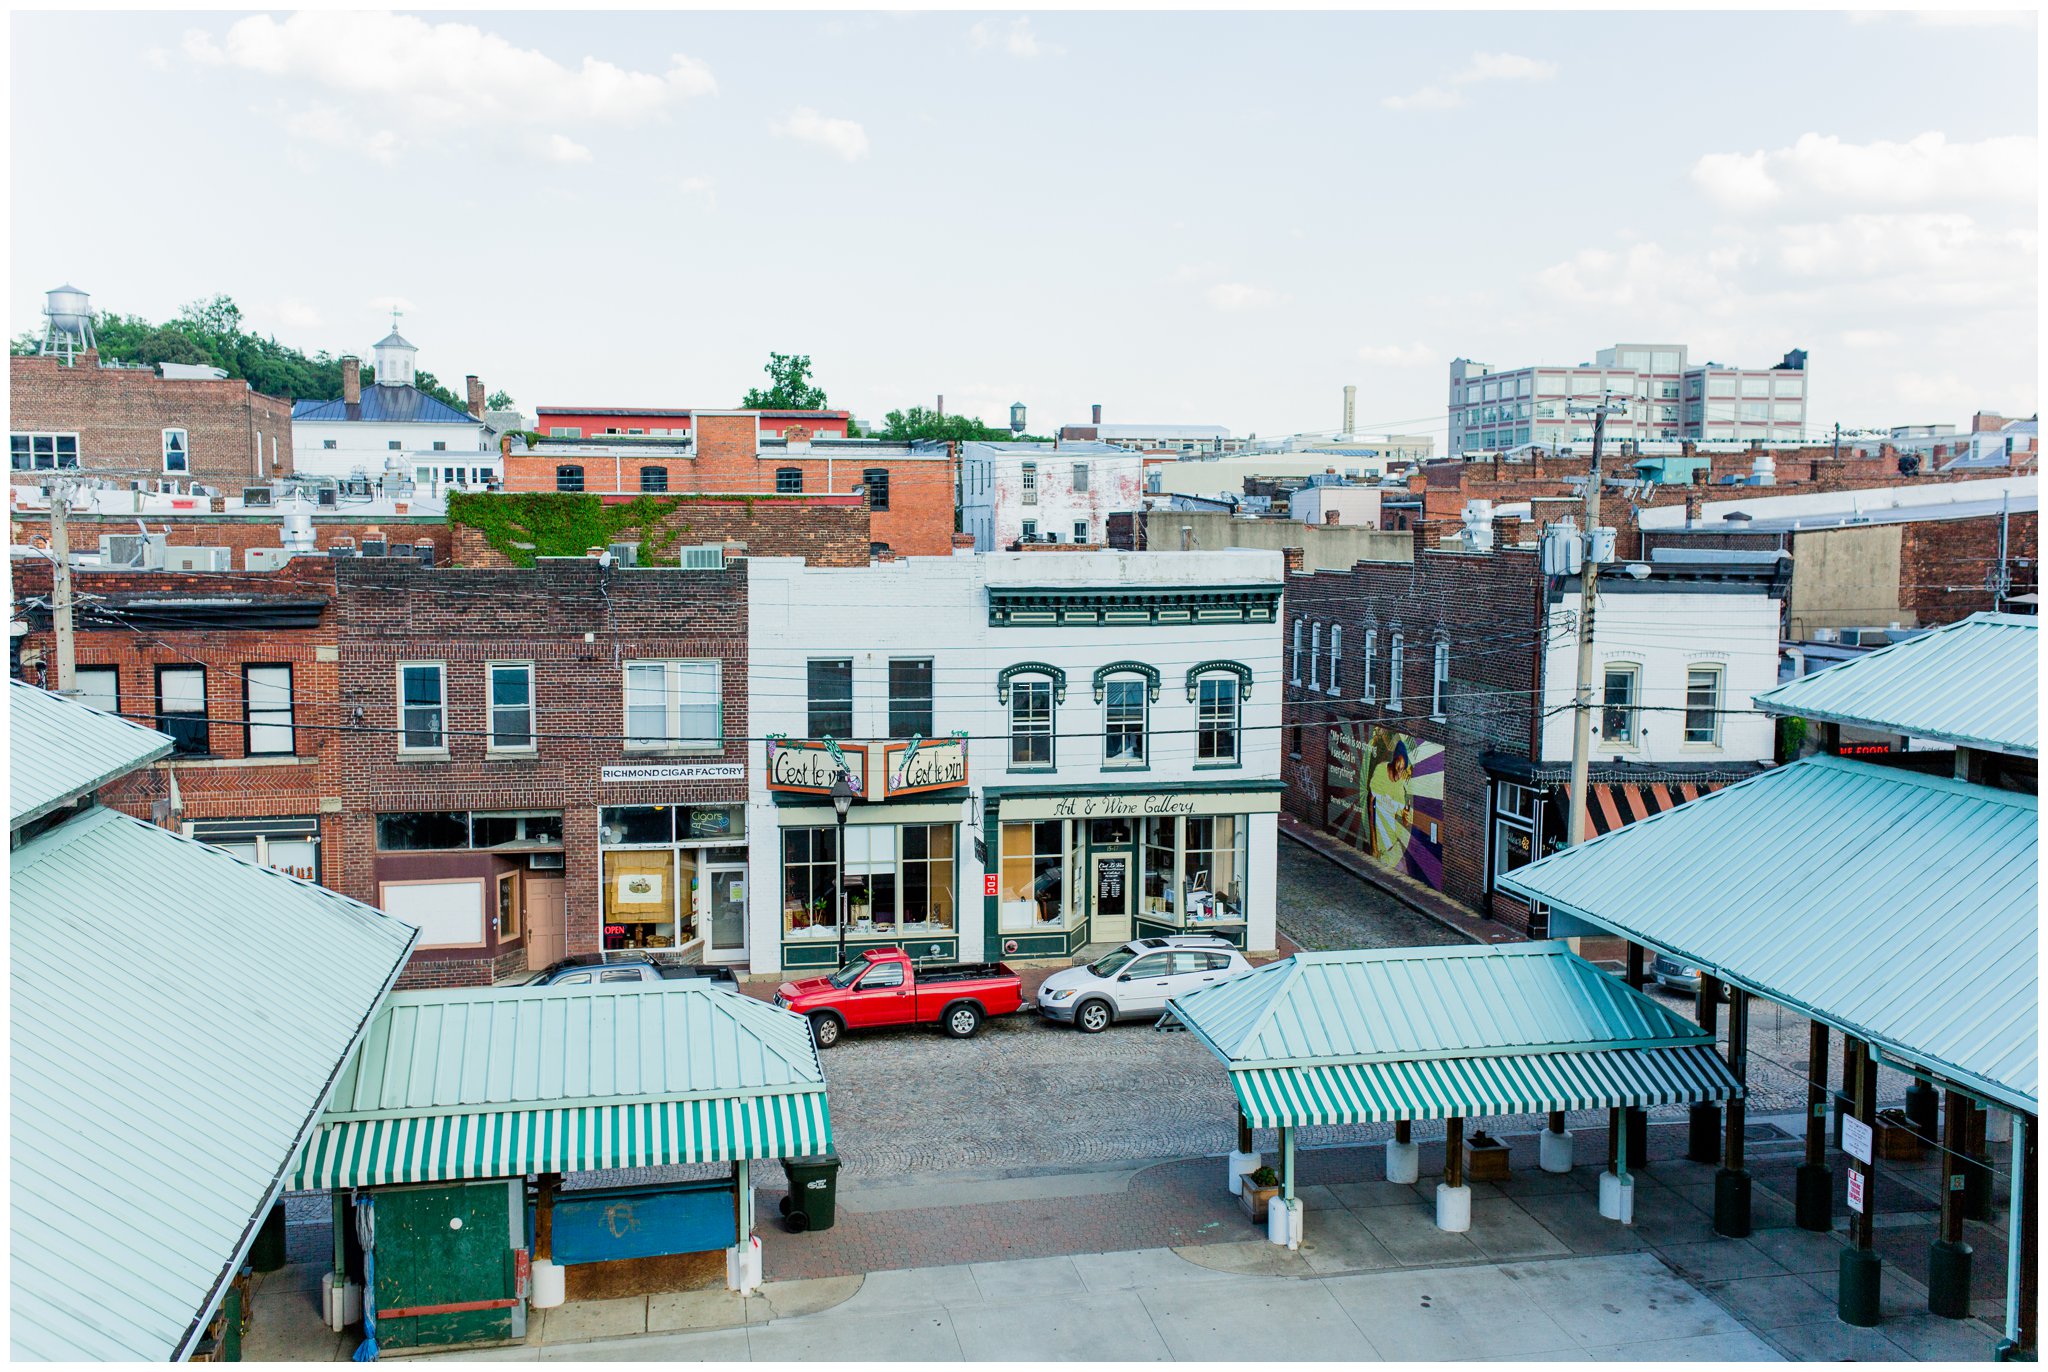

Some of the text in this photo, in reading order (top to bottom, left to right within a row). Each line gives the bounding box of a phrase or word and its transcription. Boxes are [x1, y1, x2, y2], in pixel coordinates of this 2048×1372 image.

[1333, 749, 1341, 760] see
[1341, 750, 1351, 763] God
[603, 767, 743, 778] RICHMOND CIGAR FACTORY
[775, 751, 808, 785] C'est
[812, 754, 824, 785] le
[905, 751, 962, 786] C'est le vin
[1053, 797, 1076, 816] Art
[1084, 798, 1096, 816] &
[1102, 796, 1137, 814] Wine
[691, 811, 723, 822] Cigars
[987, 875, 996, 894] FDC
[604, 925, 625, 935] OPEN
